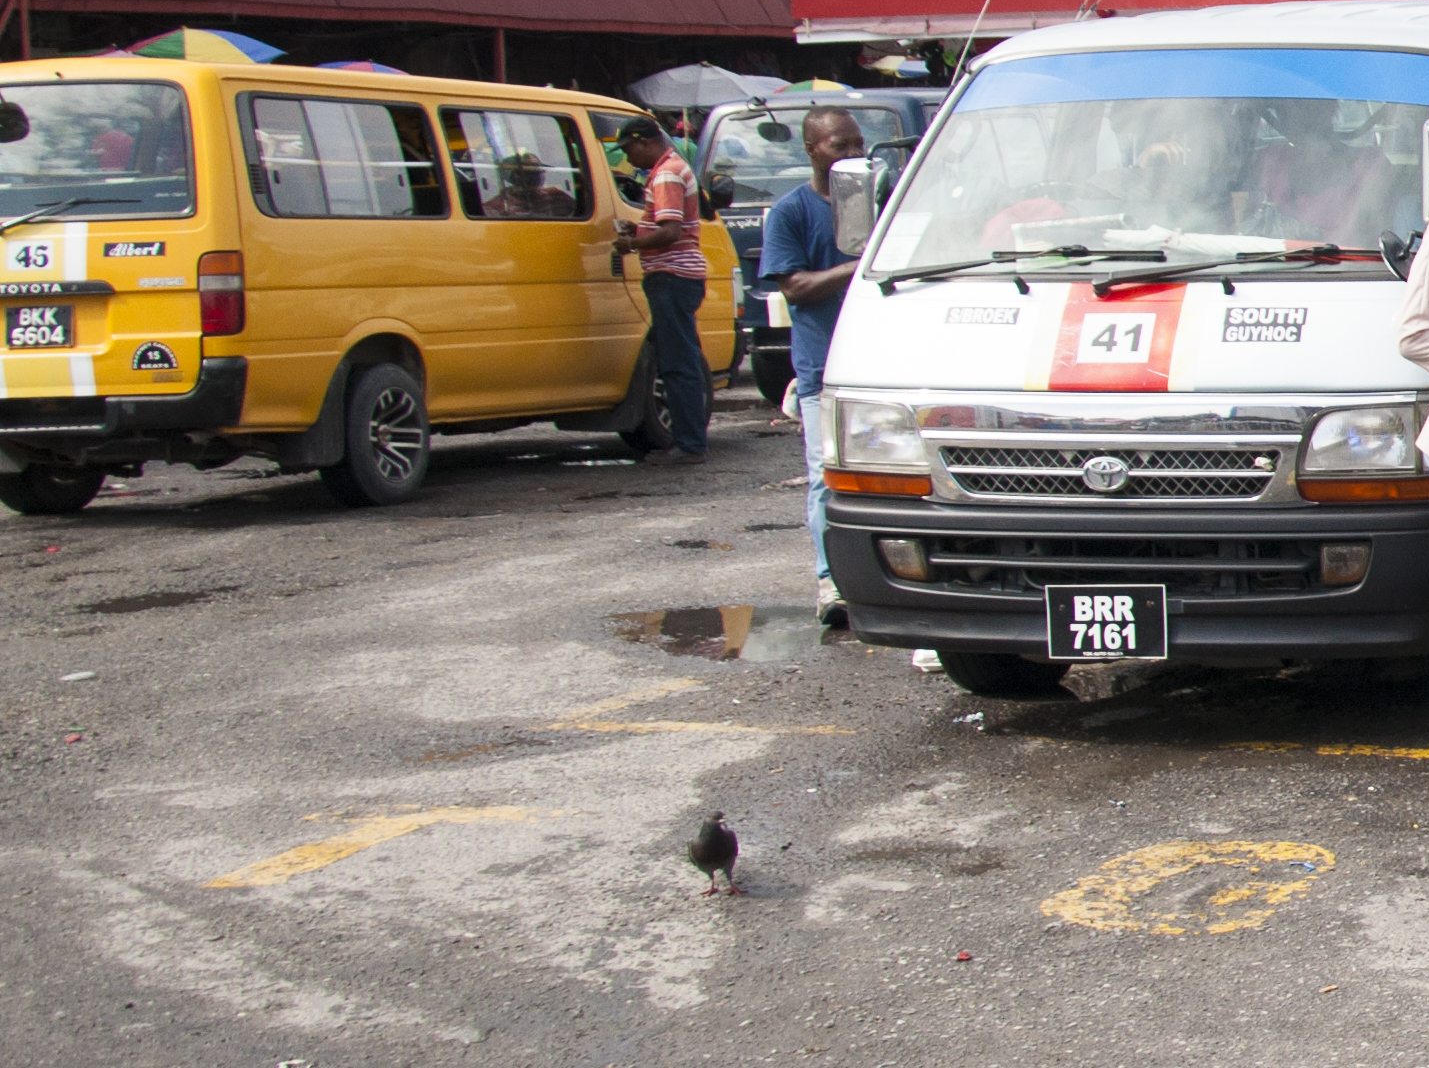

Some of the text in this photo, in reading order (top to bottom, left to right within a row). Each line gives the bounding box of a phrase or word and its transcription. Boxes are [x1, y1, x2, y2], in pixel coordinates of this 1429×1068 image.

[15, 246, 49, 268] 45
[109, 243, 160, 256] Albert
[19, 308, 57, 326] BKK
[1228, 308, 1304, 325] SOUTH
[12, 327, 64, 345] 5604
[1091, 323, 1143, 352] 41
[1225, 325, 1297, 342] GUYHOC
[1073, 595, 1135, 621] BRR
[1069, 623, 1136, 649] 7161
